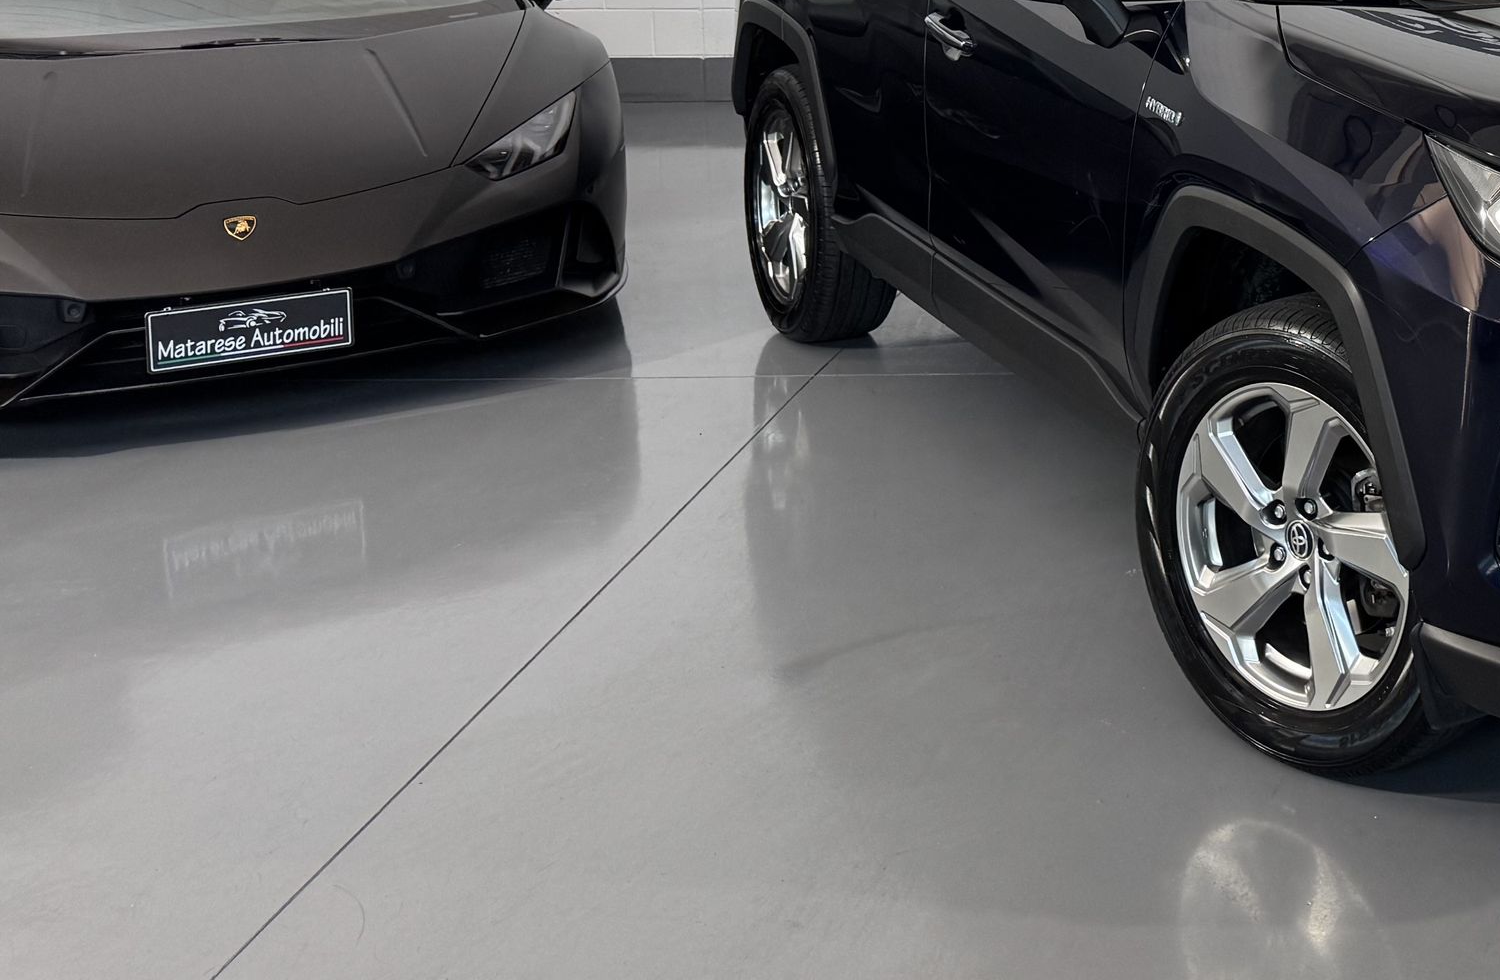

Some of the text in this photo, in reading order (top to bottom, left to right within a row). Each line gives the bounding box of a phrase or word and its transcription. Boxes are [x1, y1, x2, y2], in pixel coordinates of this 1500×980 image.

[1145, 96, 1176, 124] HYBRID
[157, 317, 344, 360] Matarese Automobili
